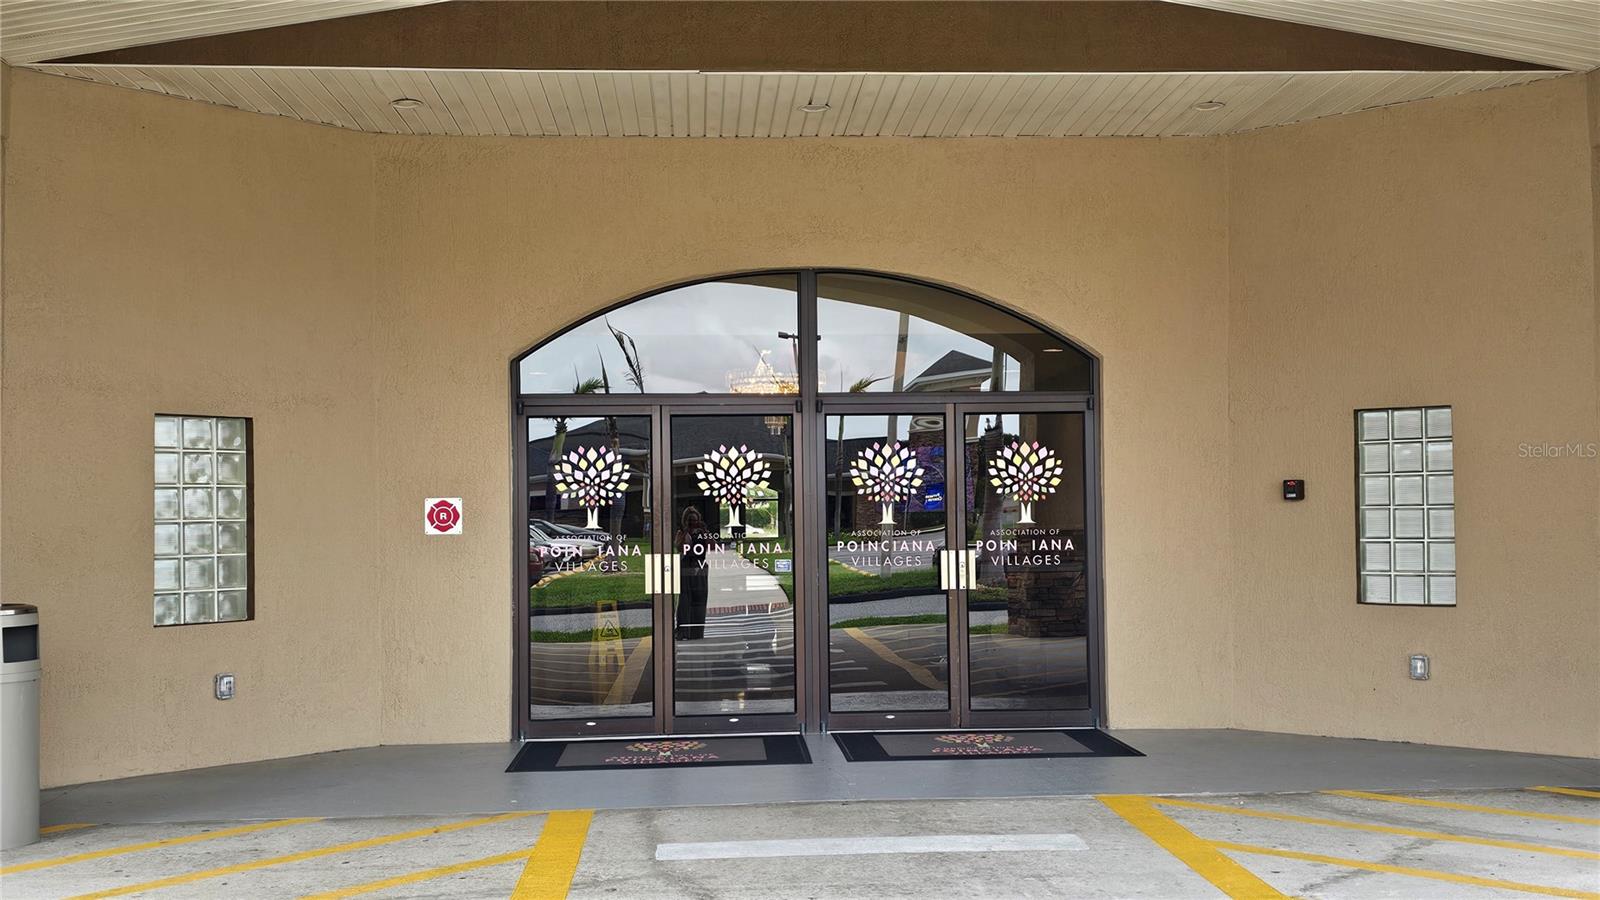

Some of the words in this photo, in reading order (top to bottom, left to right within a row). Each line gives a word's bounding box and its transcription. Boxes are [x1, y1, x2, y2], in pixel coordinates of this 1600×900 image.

[439, 512, 447, 520] R
[851, 529, 907, 537] ASSOCIATION
[909, 529, 921, 537] OF
[990, 528, 1046, 536] ASSOCIATION
[837, 540, 936, 552] POINCIANA
[697, 558, 769, 570] VILLAGES
[851, 556, 922, 567] VILLAGES
[990, 554, 1061, 566] VILLAGES
[554, 560, 629, 572] VILLAGES
